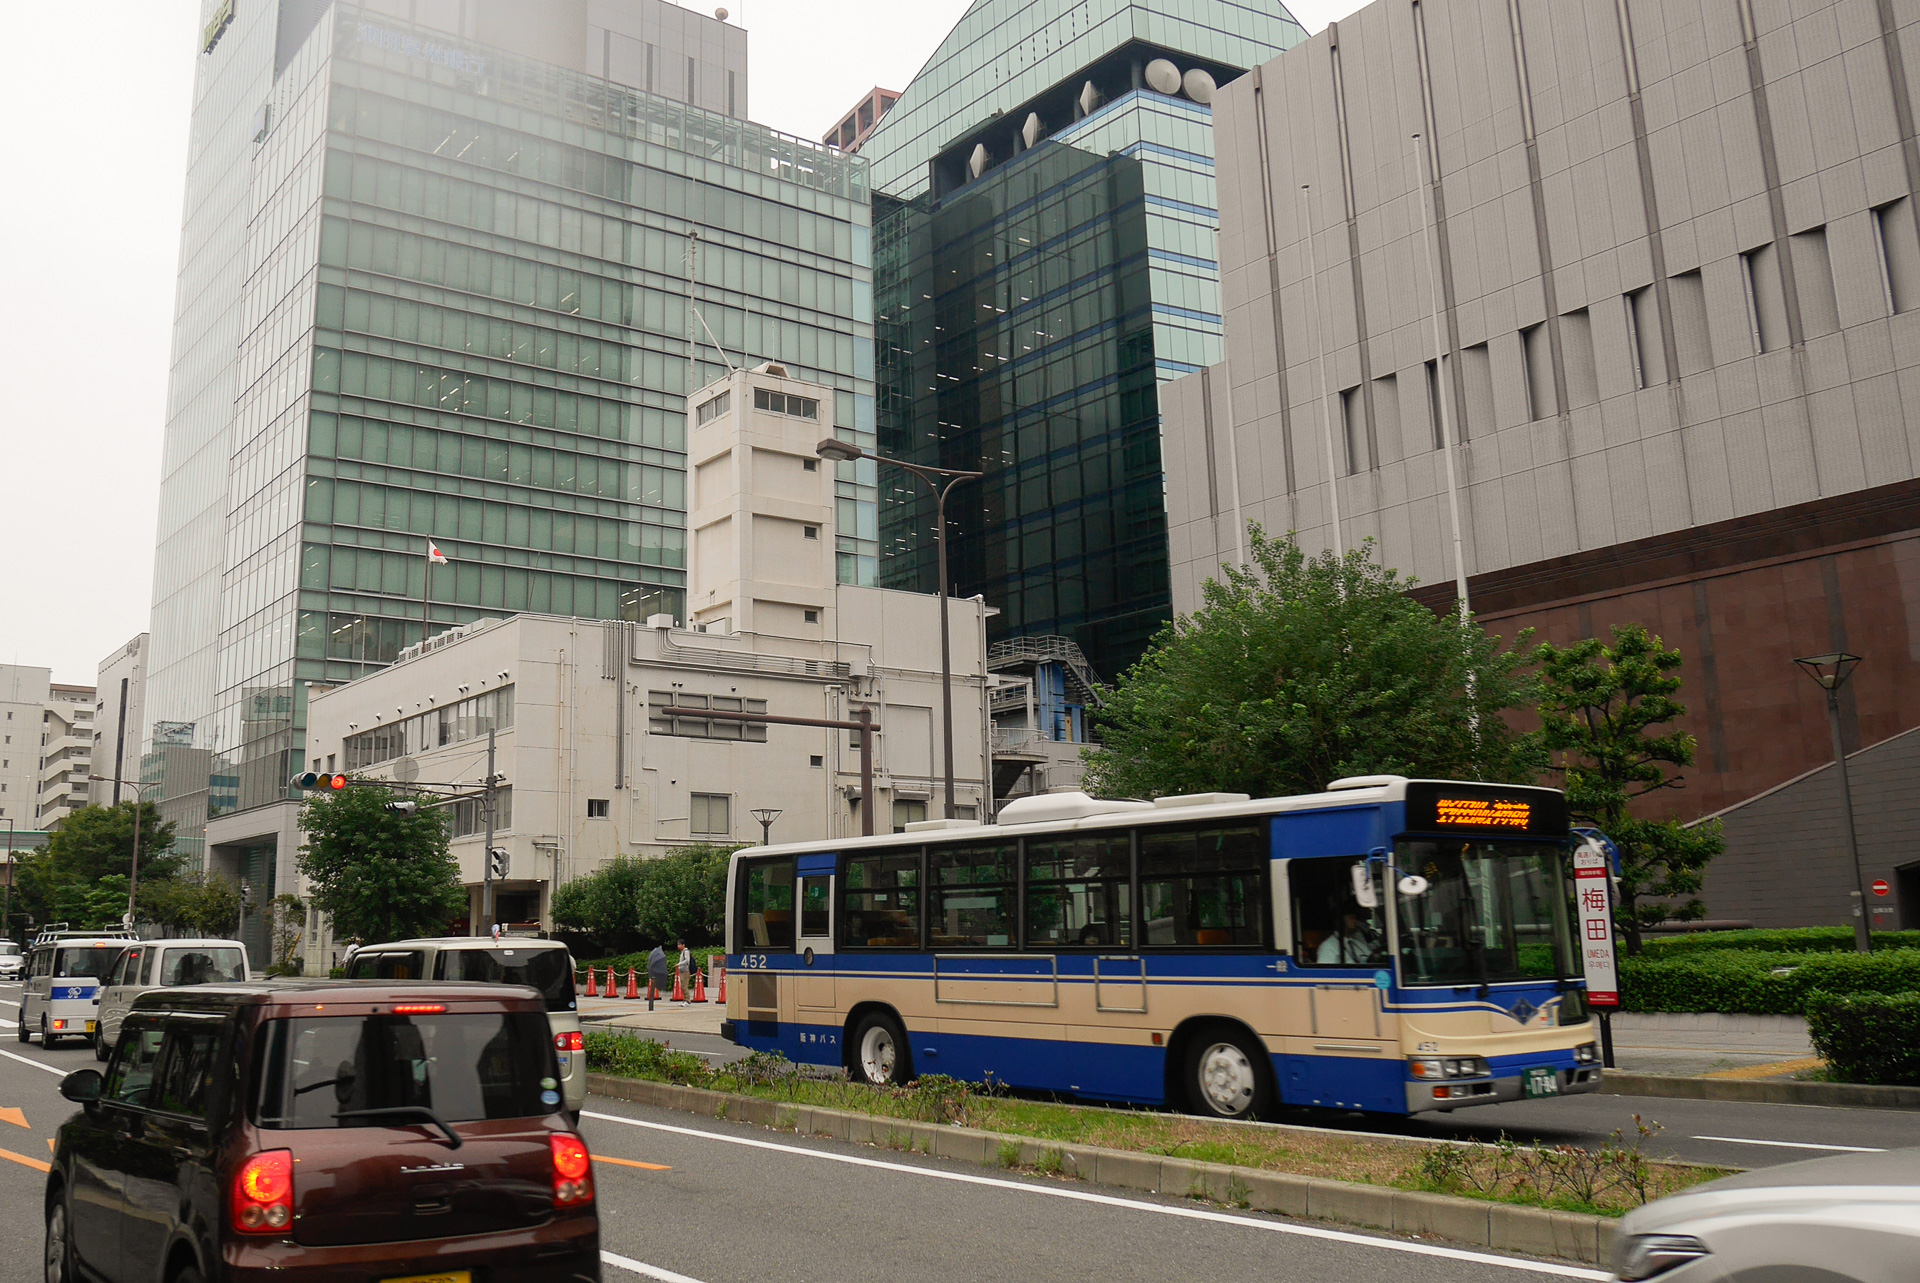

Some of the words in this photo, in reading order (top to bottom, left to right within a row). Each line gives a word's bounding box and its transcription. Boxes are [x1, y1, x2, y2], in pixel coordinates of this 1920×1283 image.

[357, 22, 485, 77] 池田泉州銀行
[1582, 887, 1607, 941] 梅田
[1587, 949, 1610, 959] UMEDA
[740, 954, 767, 969] 452
[1588, 961, 1610, 969] 우메다
[799, 1032, 837, 1044] 阪神バス
